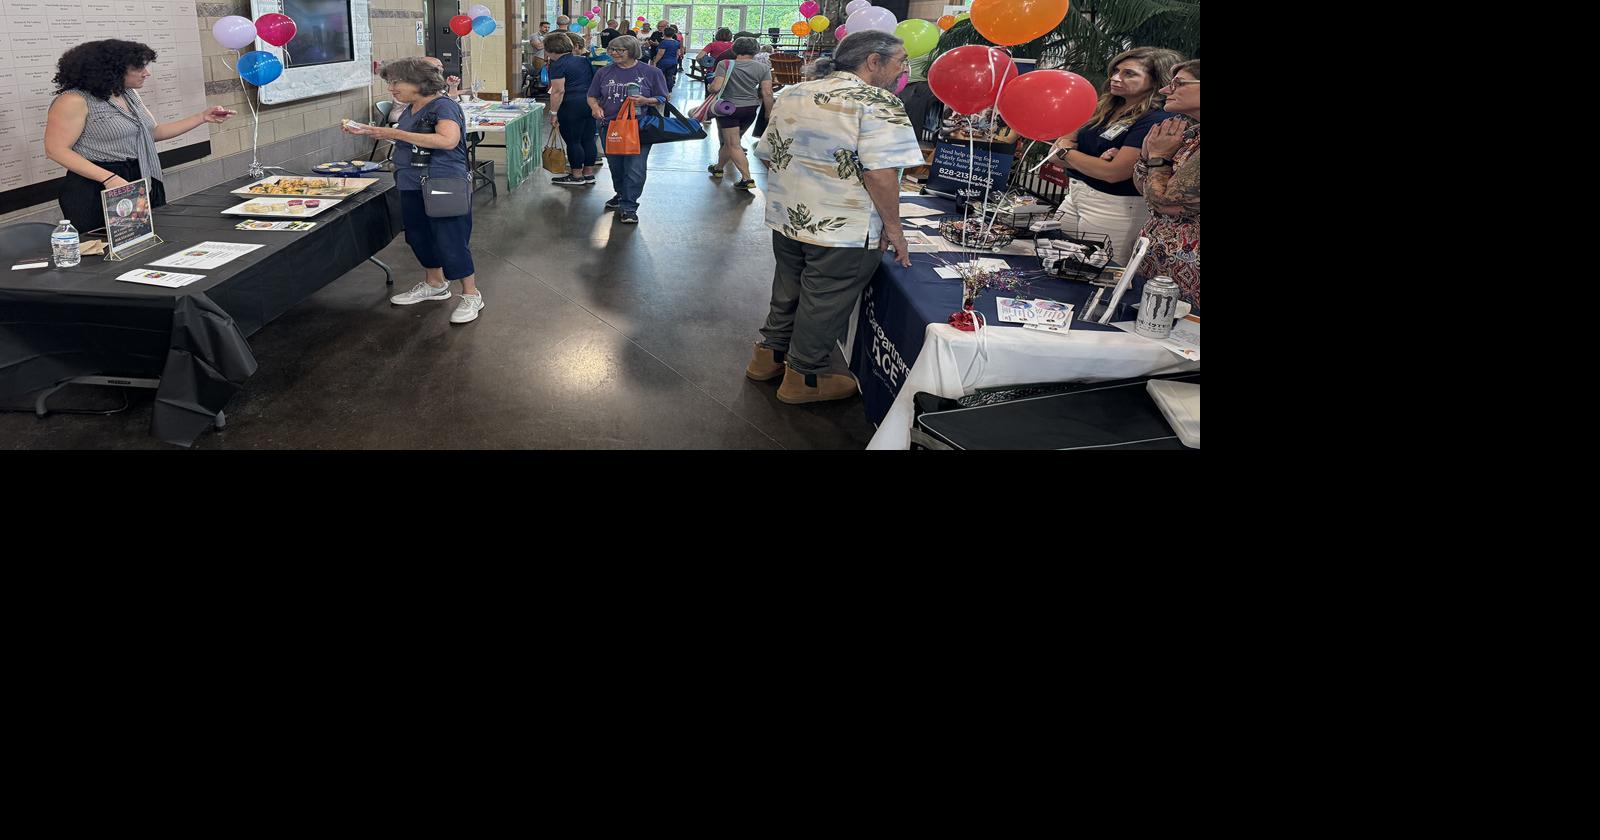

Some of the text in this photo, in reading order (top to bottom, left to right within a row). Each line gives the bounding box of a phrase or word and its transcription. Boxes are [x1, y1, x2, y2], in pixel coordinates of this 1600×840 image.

[940, 147, 954, 155] Need
[954, 150, 966, 158] help
[938, 167, 995, 185] 828-2138442
